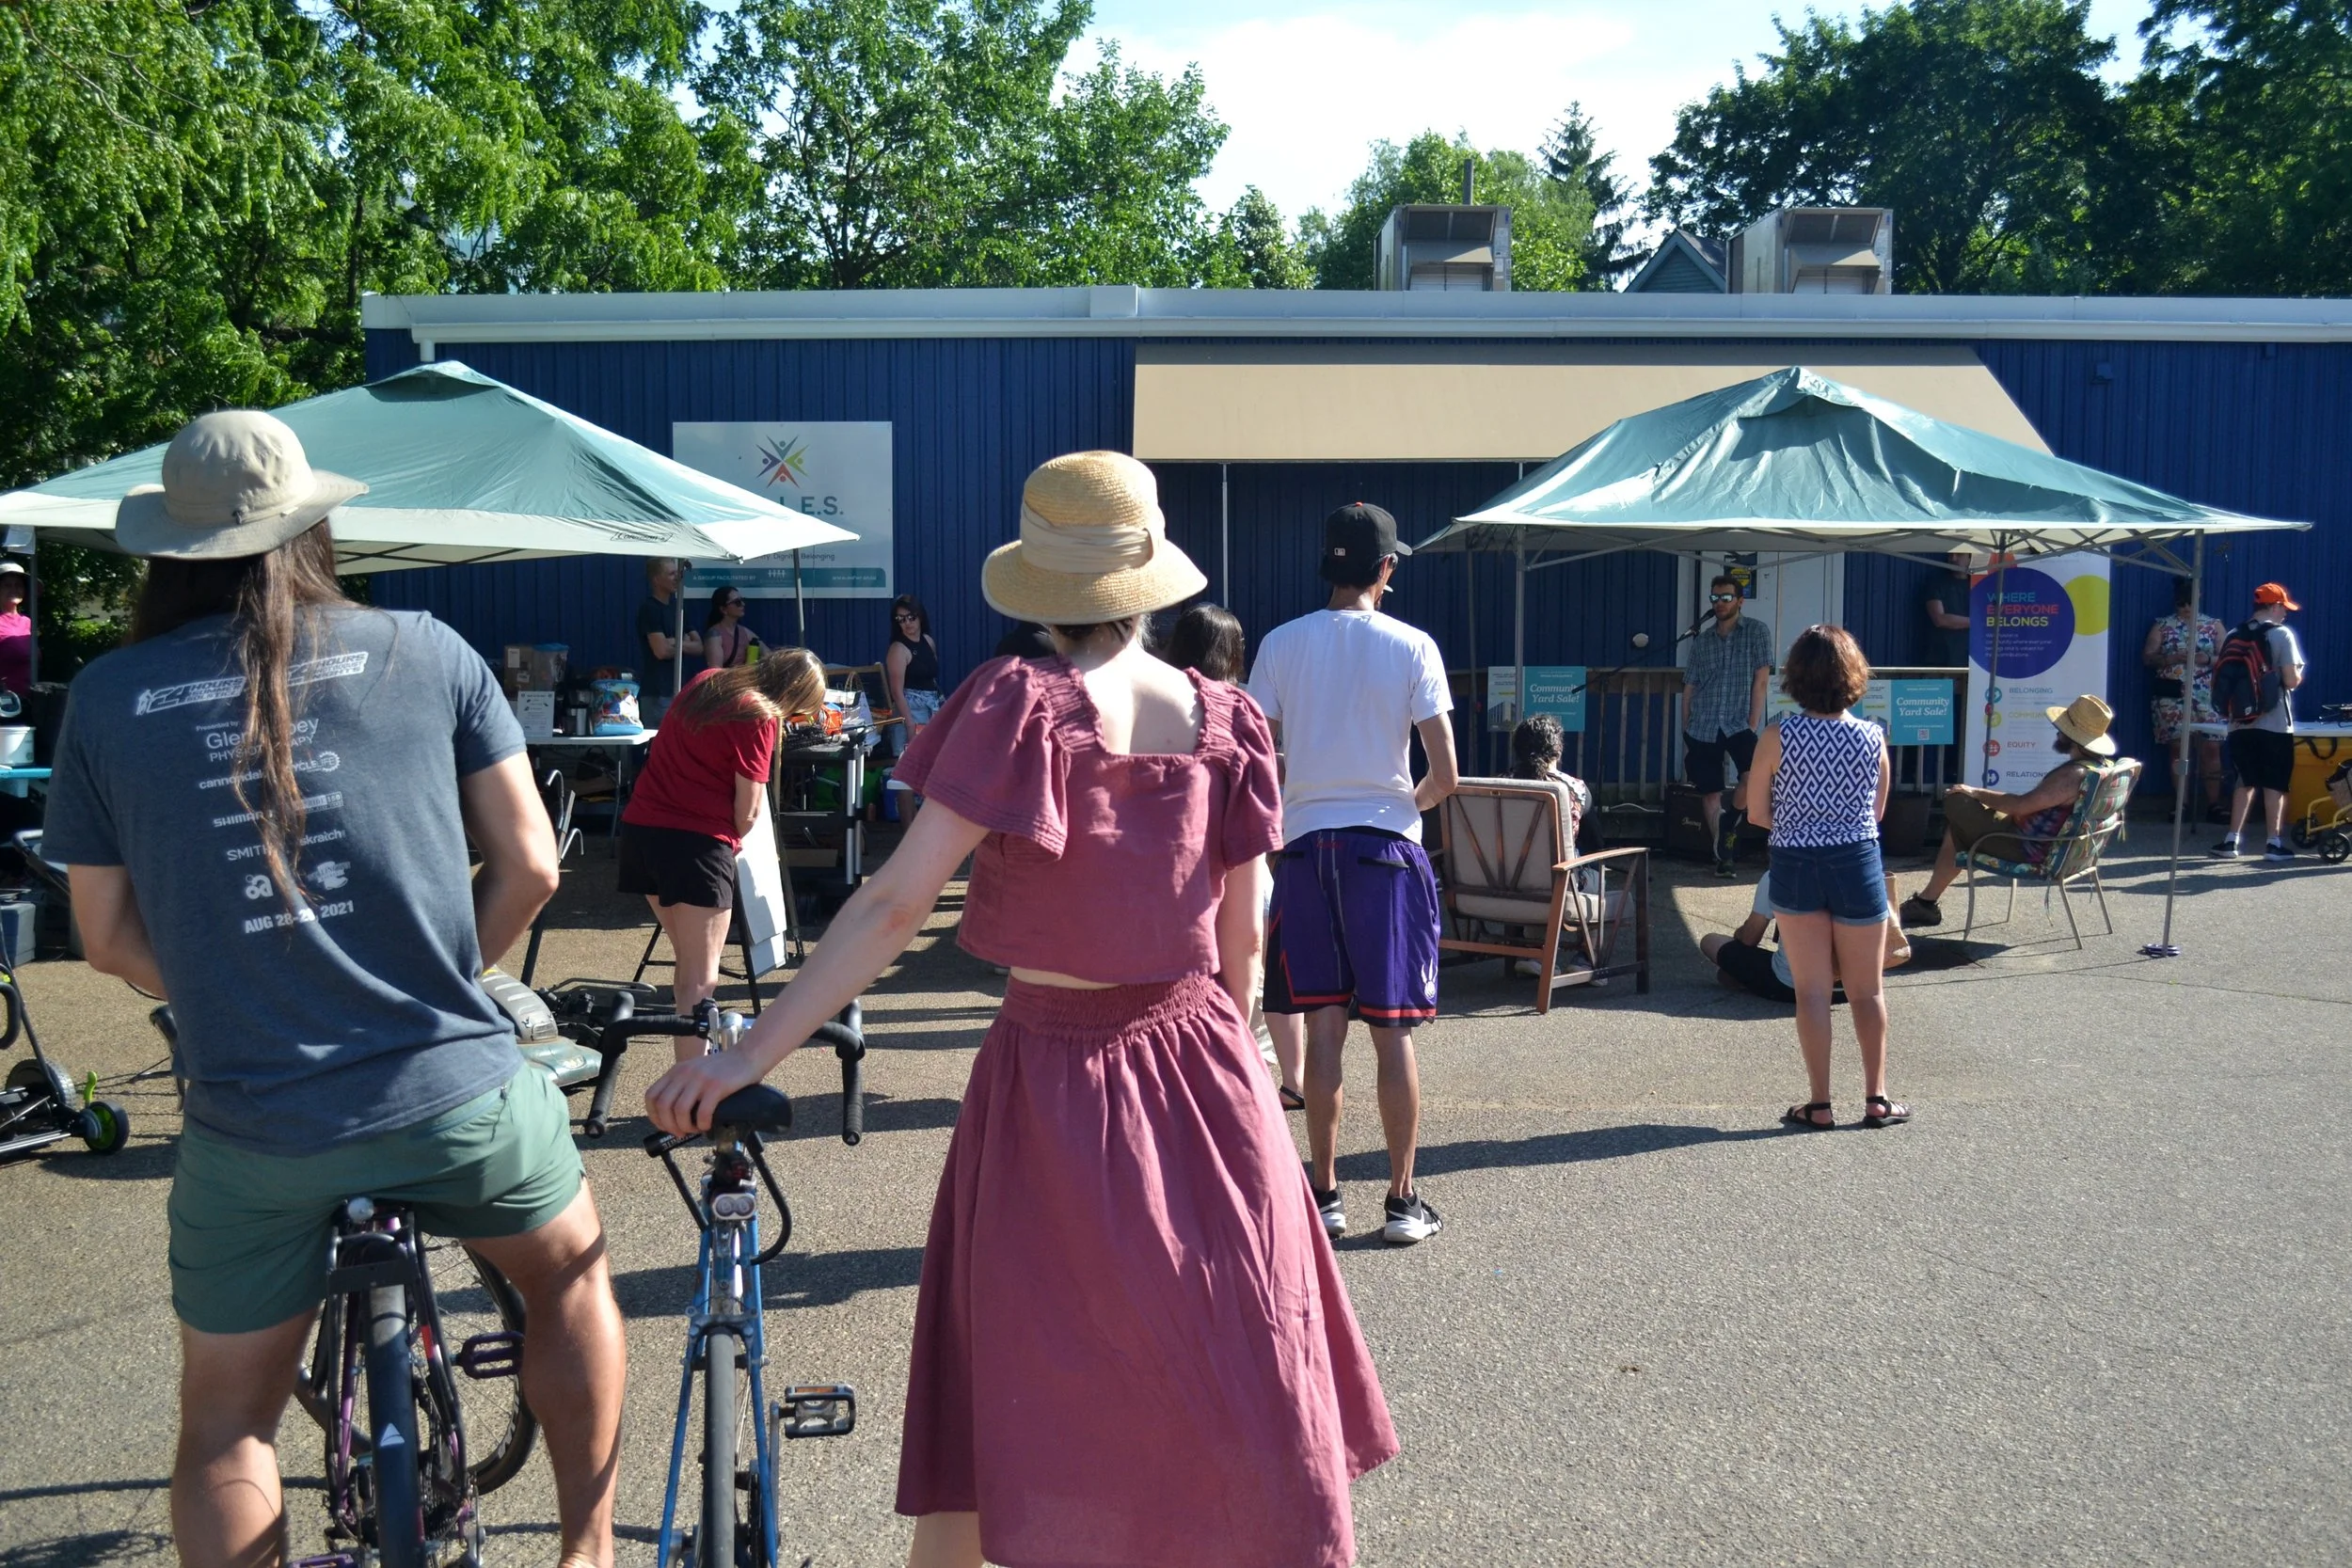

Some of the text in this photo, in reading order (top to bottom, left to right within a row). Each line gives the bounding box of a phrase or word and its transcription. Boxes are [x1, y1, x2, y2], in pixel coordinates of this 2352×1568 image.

[773, 553, 795, 562] Dignit
[801, 553, 835, 562] Belonging
[1986, 592, 2036, 603] WHERE
[1986, 604, 2059, 615] EVERYONE
[1986, 616, 2049, 627] BELONGS
[190, 677, 244, 691] HOURS
[1532, 694, 1580, 704] Yard Sale!
[1896, 697, 1950, 706] Community
[1899, 707, 1947, 716] Yard Sale!
[199, 770, 266, 789] cannondal
[213, 809, 273, 828] SHIMAN
[245, 915, 274, 933] AUG
[320, 899, 355, 919] 2021
